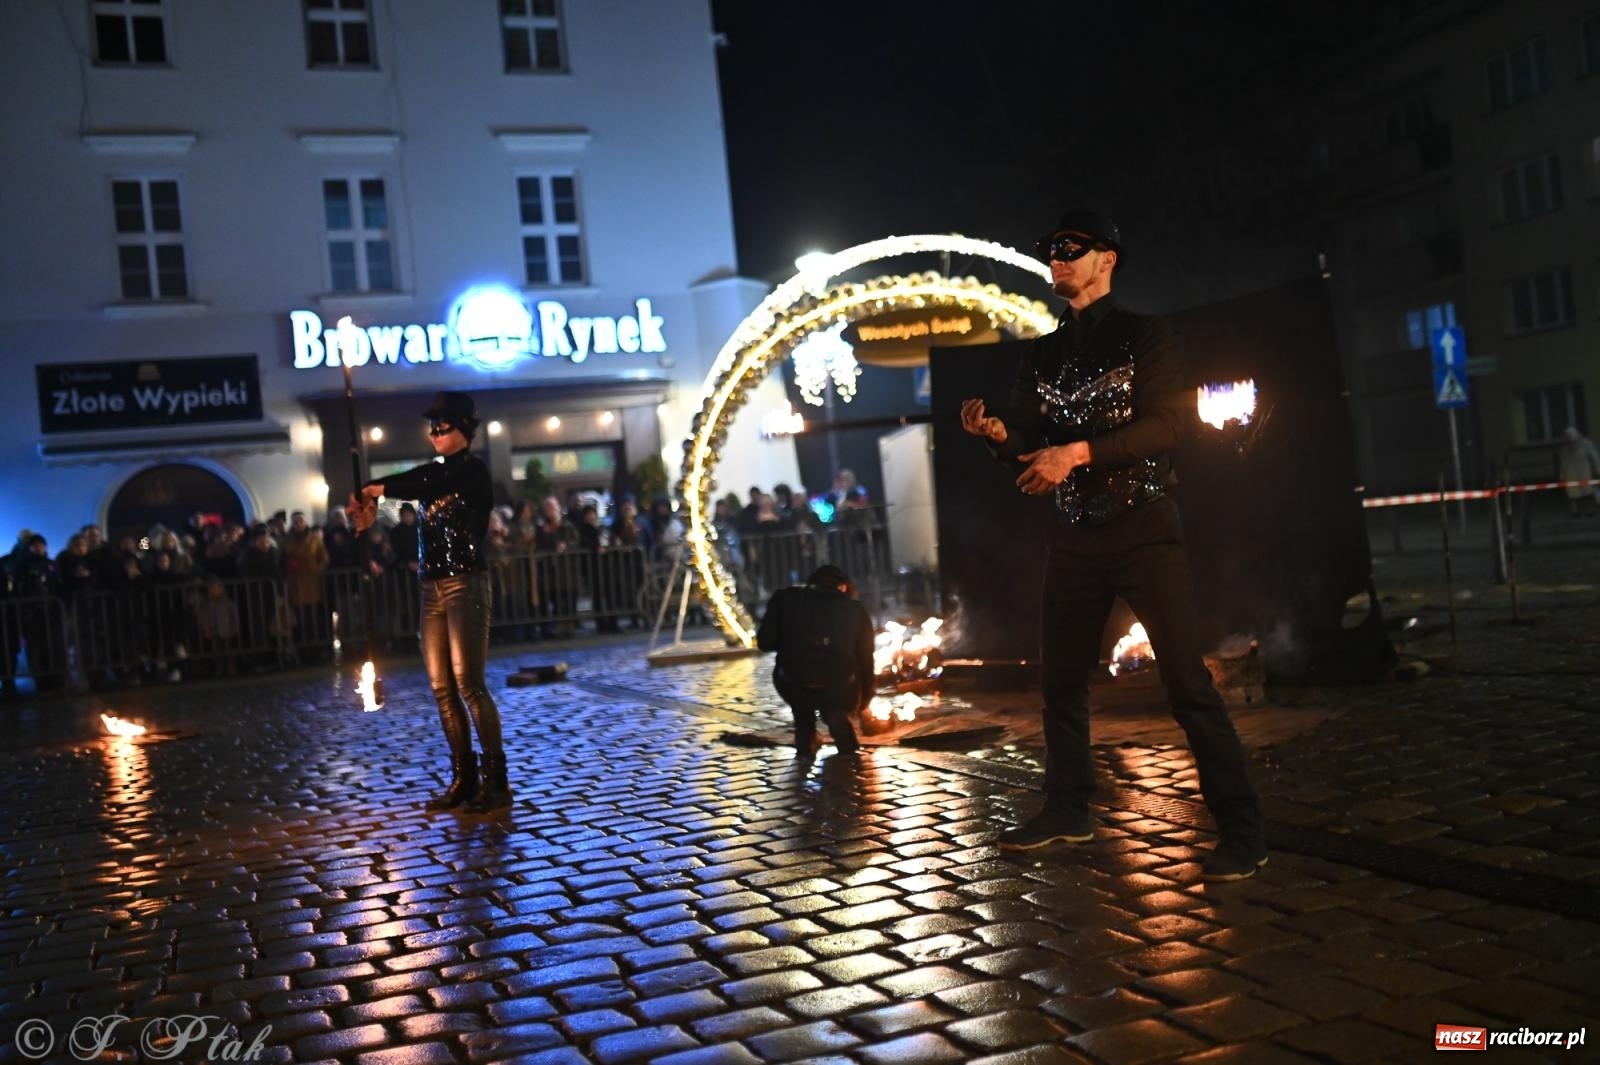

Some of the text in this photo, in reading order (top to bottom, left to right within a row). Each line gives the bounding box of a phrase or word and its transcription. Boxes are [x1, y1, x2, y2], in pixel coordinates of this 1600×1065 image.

[290, 299, 667, 369] Browar Rynek
[132, 380, 248, 415] Wypieki
